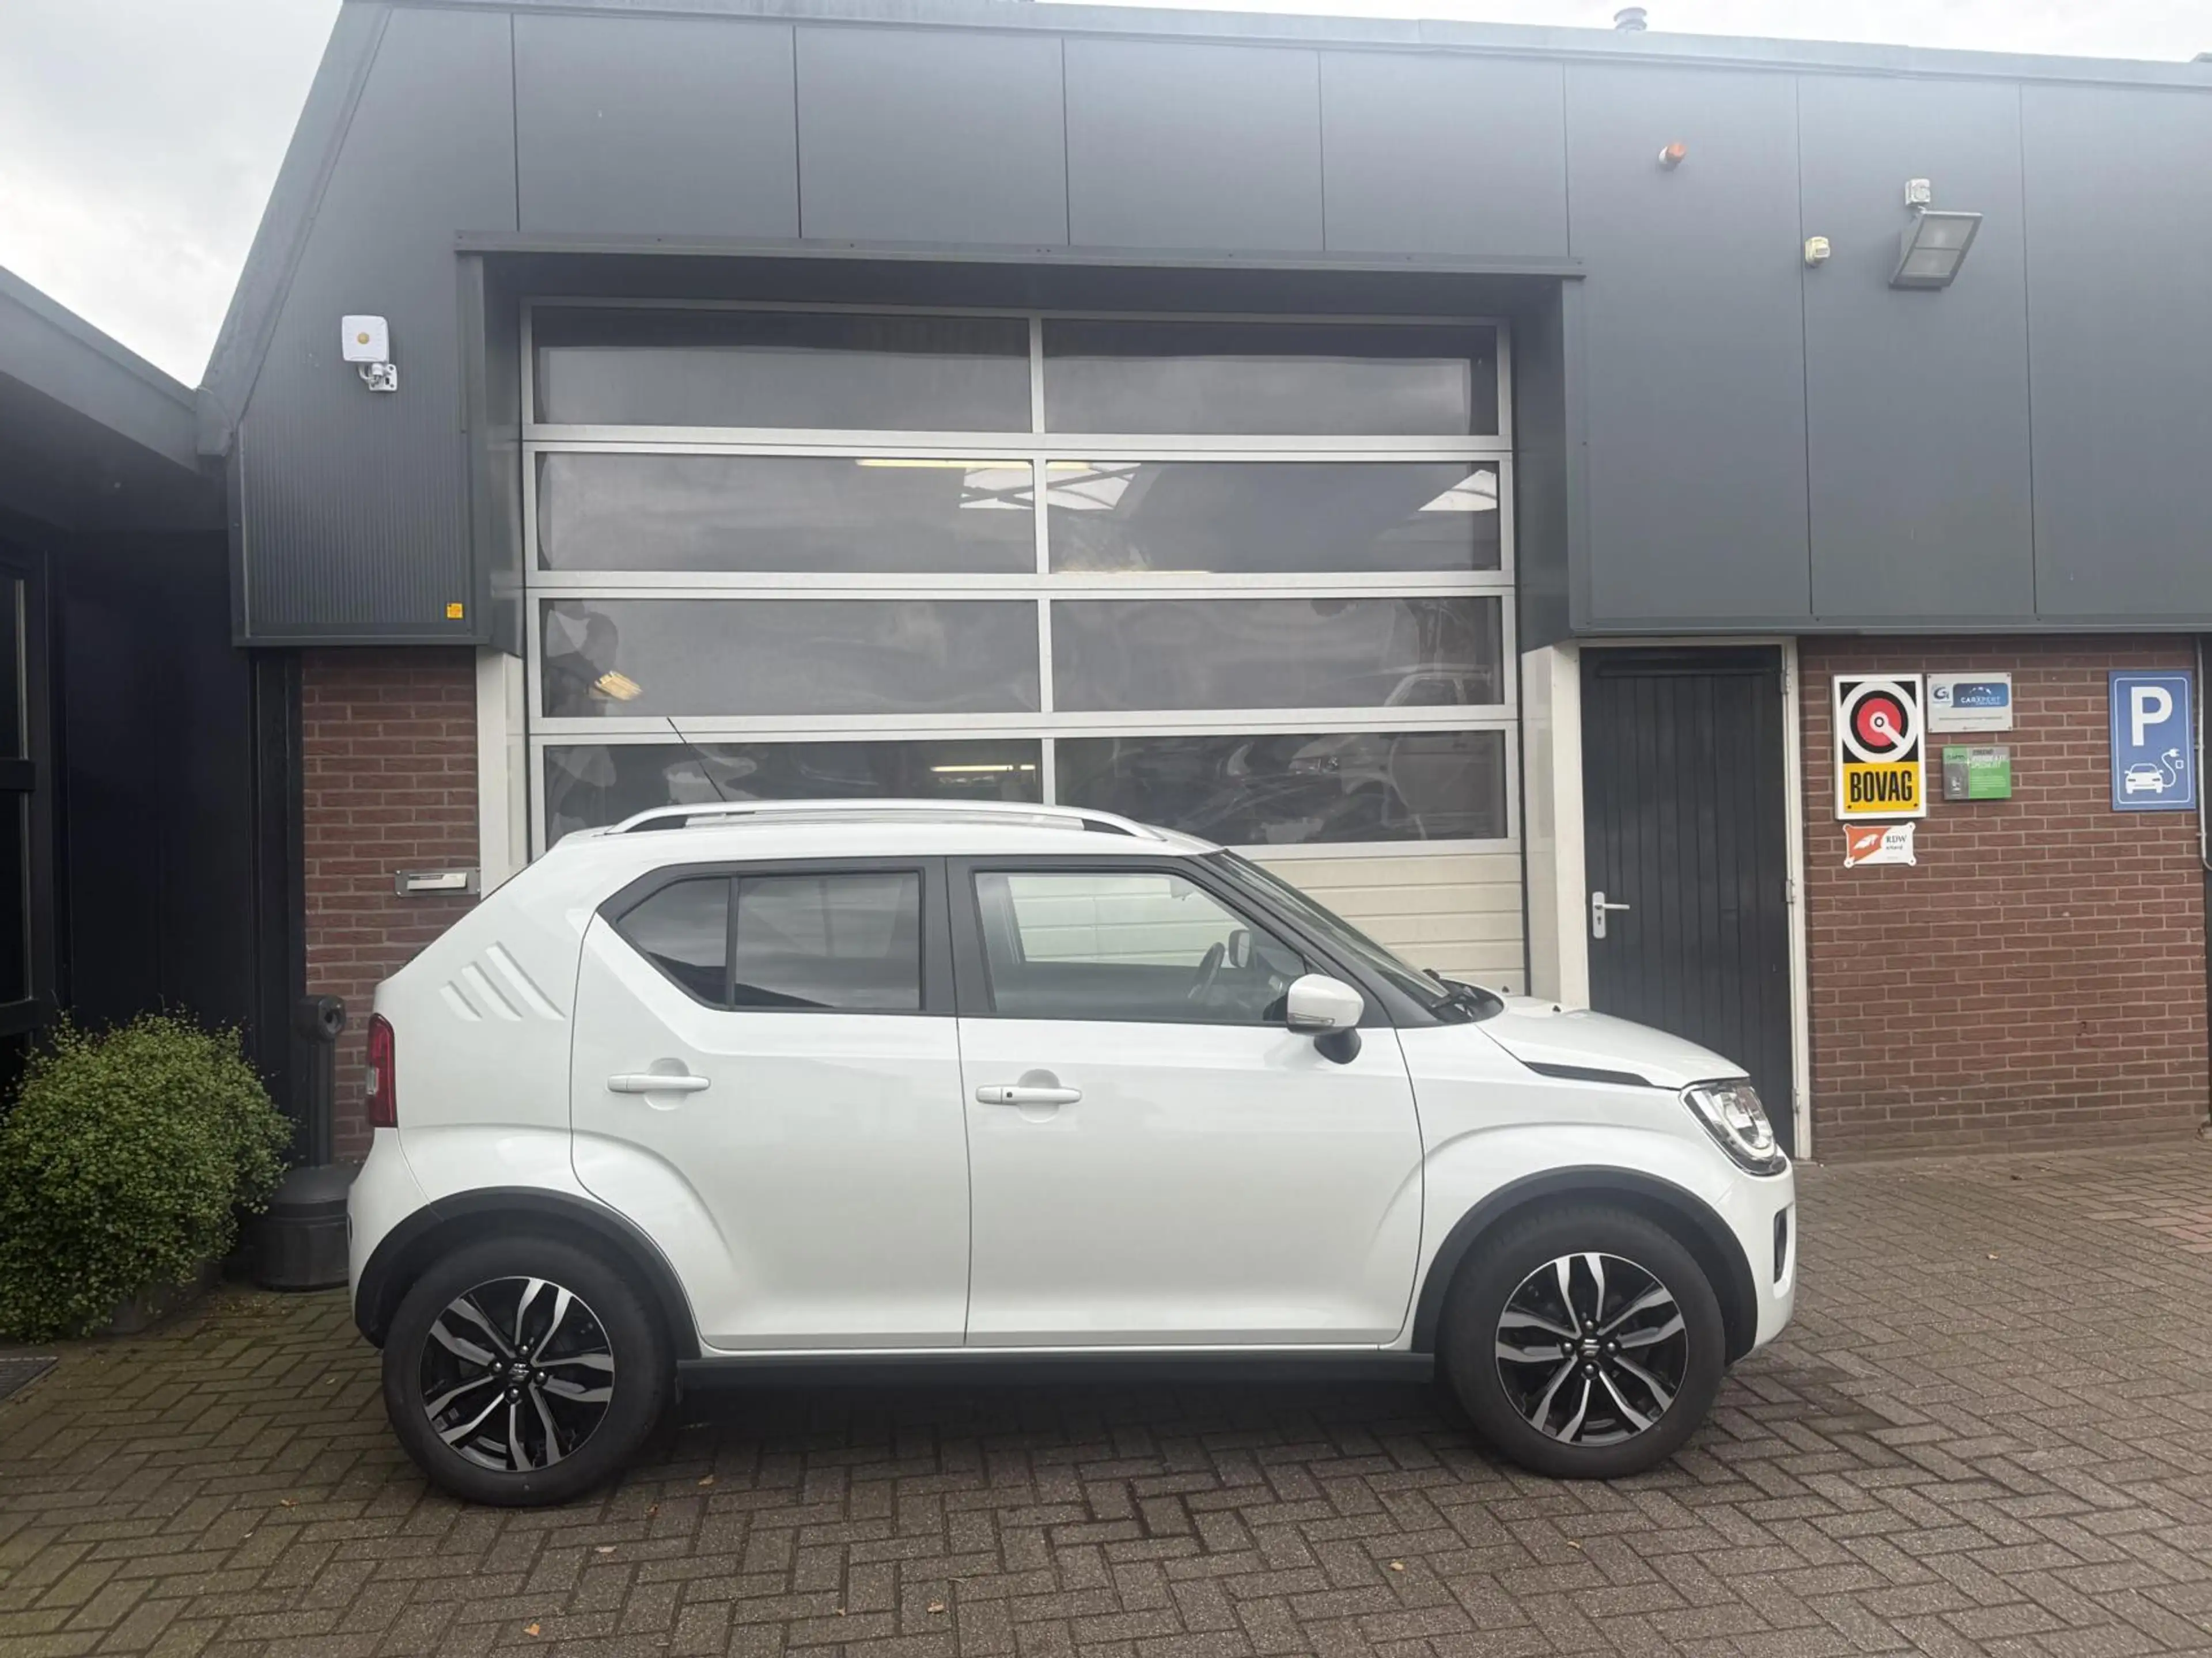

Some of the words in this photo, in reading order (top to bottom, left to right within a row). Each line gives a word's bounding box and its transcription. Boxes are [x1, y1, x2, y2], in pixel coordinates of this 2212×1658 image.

[2131, 686, 2173, 746] P
[1850, 770, 1912, 802] BOVAG
[1886, 834, 1907, 843] RDW
